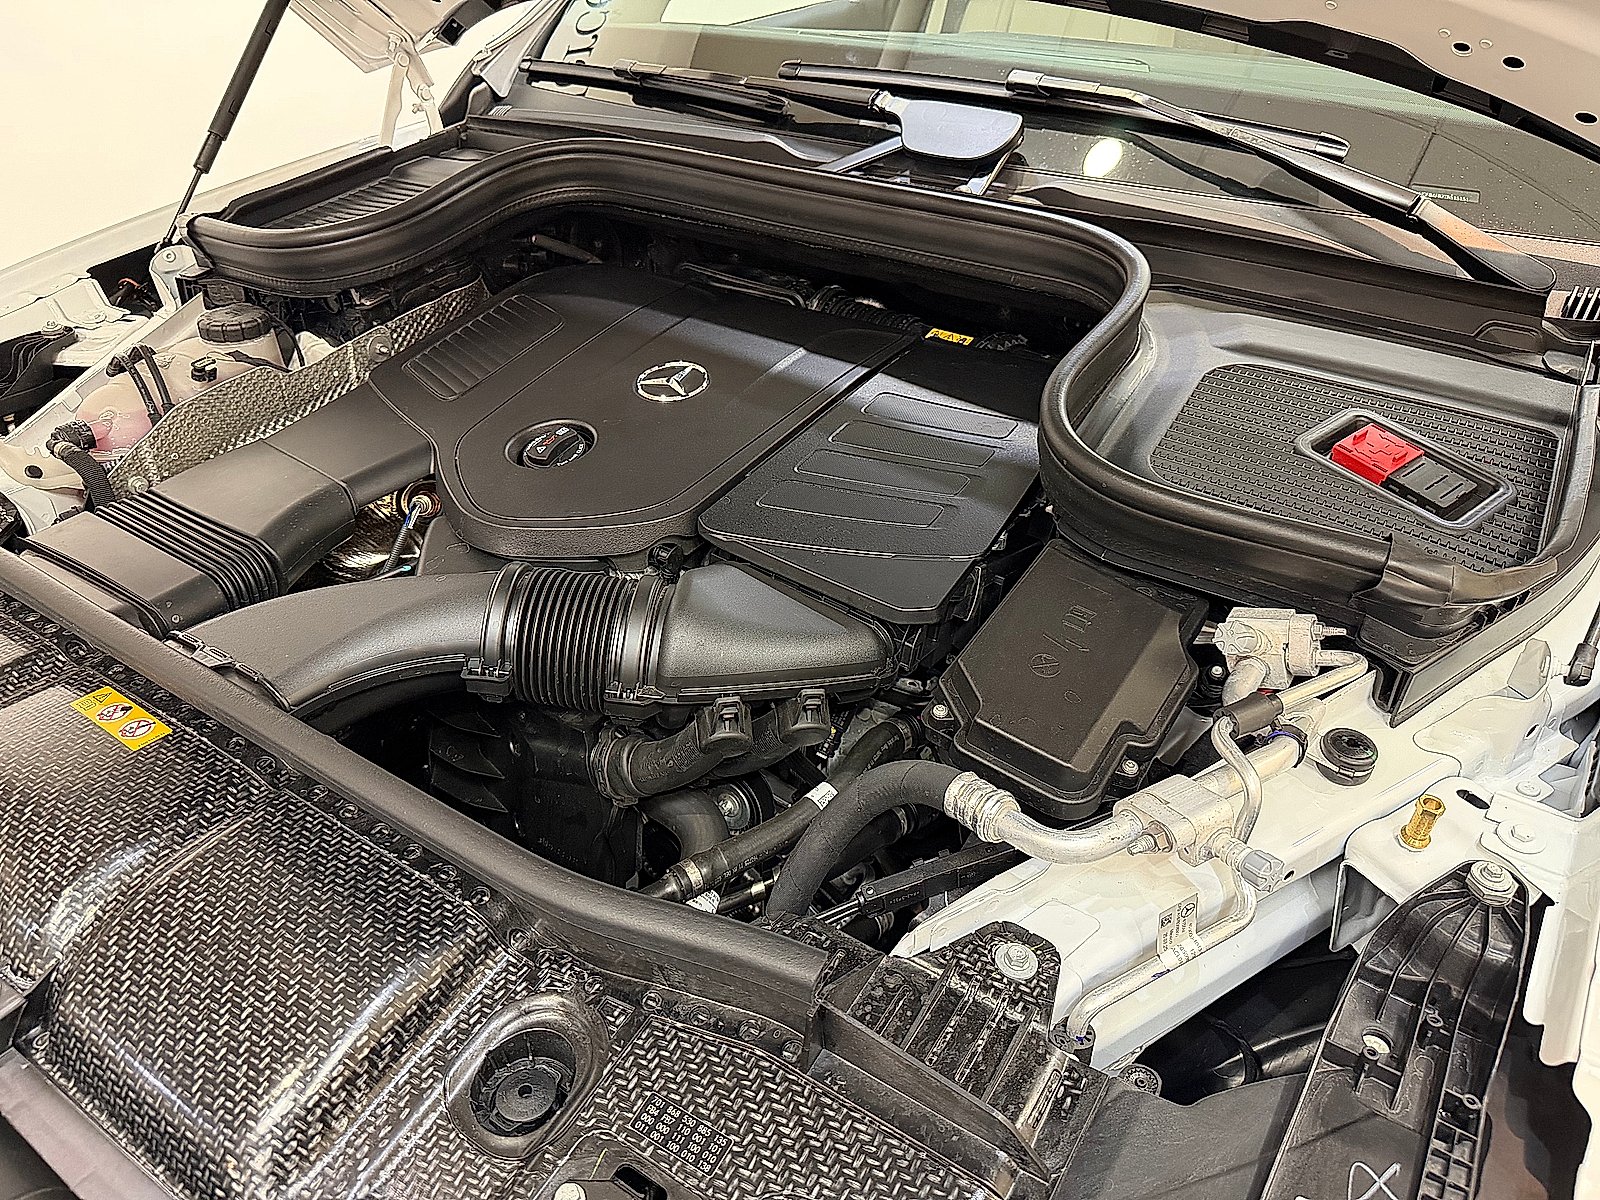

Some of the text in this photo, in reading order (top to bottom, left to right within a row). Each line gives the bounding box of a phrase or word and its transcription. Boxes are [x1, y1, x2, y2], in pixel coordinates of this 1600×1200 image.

[641, 1113, 716, 1163] 000 000 111 100 010
[651, 1096, 665, 1108] 701
[667, 1106, 681, 1118] 868
[682, 1115, 696, 1127] 530
[714, 1135, 727, 1146] 135
[677, 1124, 691, 1135] 110
[692, 1133, 706, 1145] 001
[709, 1143, 722, 1155] 101
[635, 1121, 711, 1172] 011 001 100 010 138
